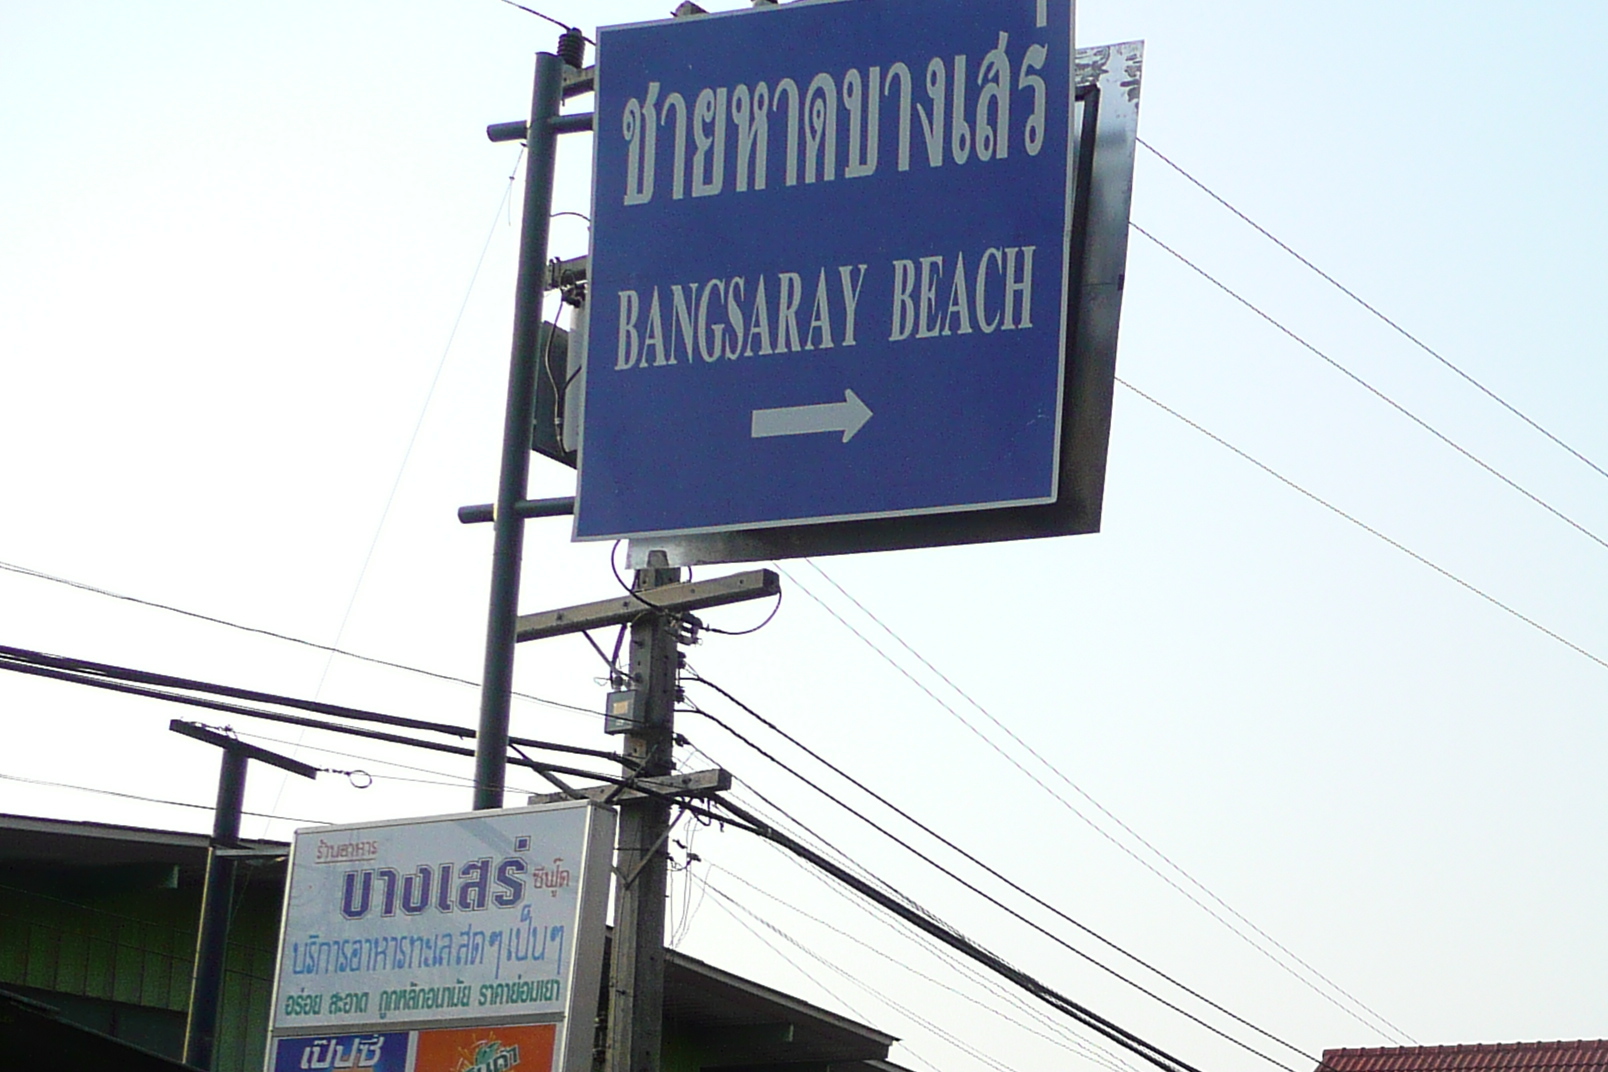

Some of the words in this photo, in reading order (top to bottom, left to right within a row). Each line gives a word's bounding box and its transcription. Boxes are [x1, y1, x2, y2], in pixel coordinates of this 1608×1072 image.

[614, 263, 867, 370] BANGSARAY
[889, 245, 1036, 342] BEACH
[316, 838, 378, 860] ร้านอาหาร
[339, 836, 531, 921] บางเสร่
[284, 988, 321, 1017] อร่อย
[328, 991, 369, 1016] สะอาด
[477, 974, 561, 1007] ราคาย่อมเยา
